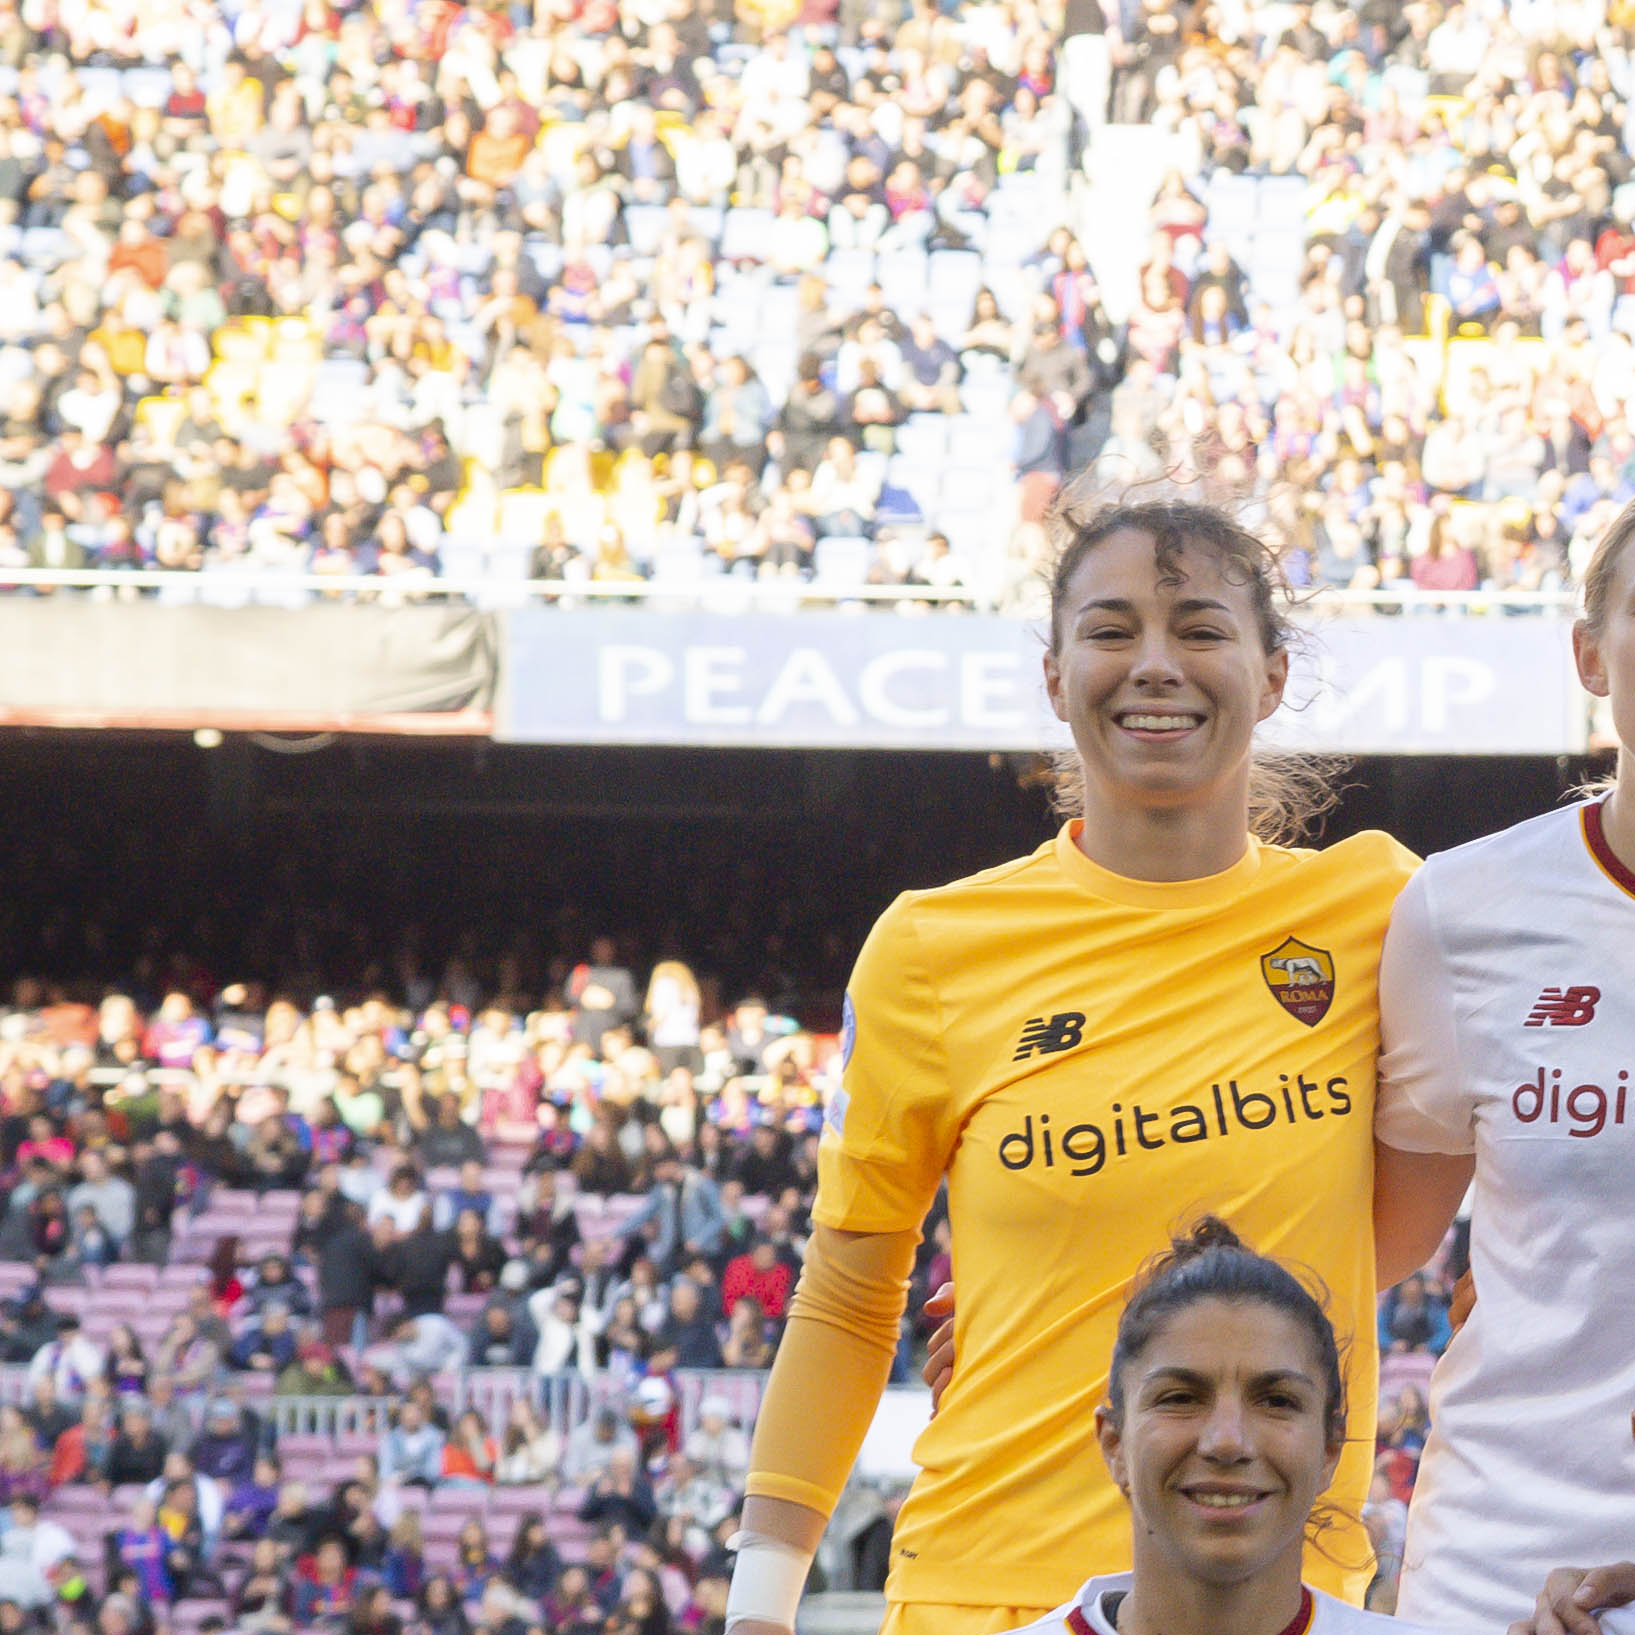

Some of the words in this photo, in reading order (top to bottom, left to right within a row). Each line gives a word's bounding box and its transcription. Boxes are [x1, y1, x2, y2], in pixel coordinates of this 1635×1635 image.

[599, 645, 1026, 729] PEACE
[1280, 989, 1329, 1002] ROMA
[999, 1074, 1352, 1176] digitalbits
